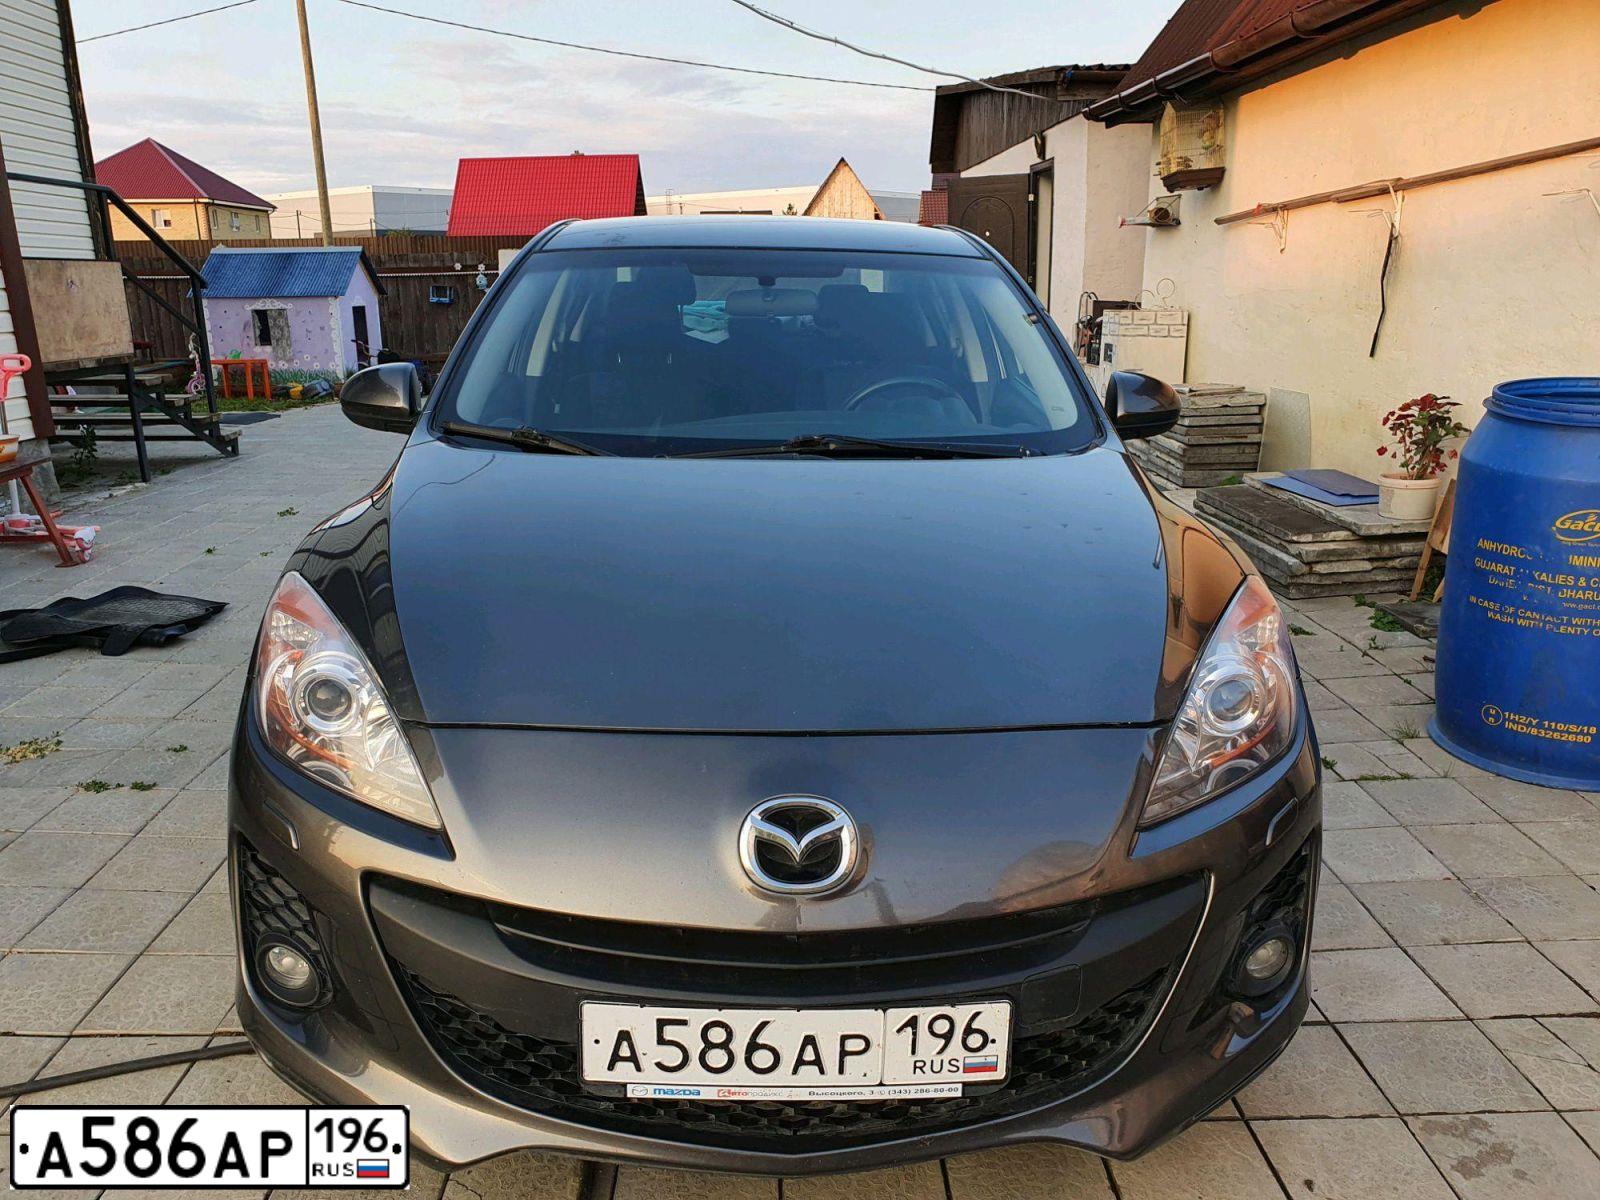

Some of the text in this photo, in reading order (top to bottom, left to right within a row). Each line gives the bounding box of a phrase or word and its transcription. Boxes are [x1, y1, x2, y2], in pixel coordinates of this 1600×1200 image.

[1474, 557, 1516, 576] GUJARAT
[1578, 577, 1587, 587] &
[1477, 599, 1500, 611] CASE
[1487, 610, 1514, 624] WASH
[1504, 711, 1597, 735] 1H2/Y 110/S/18
[895, 1010, 990, 1057] 196
[913, 1058, 961, 1075] RUS
[653, 1087, 701, 1096] mazda
